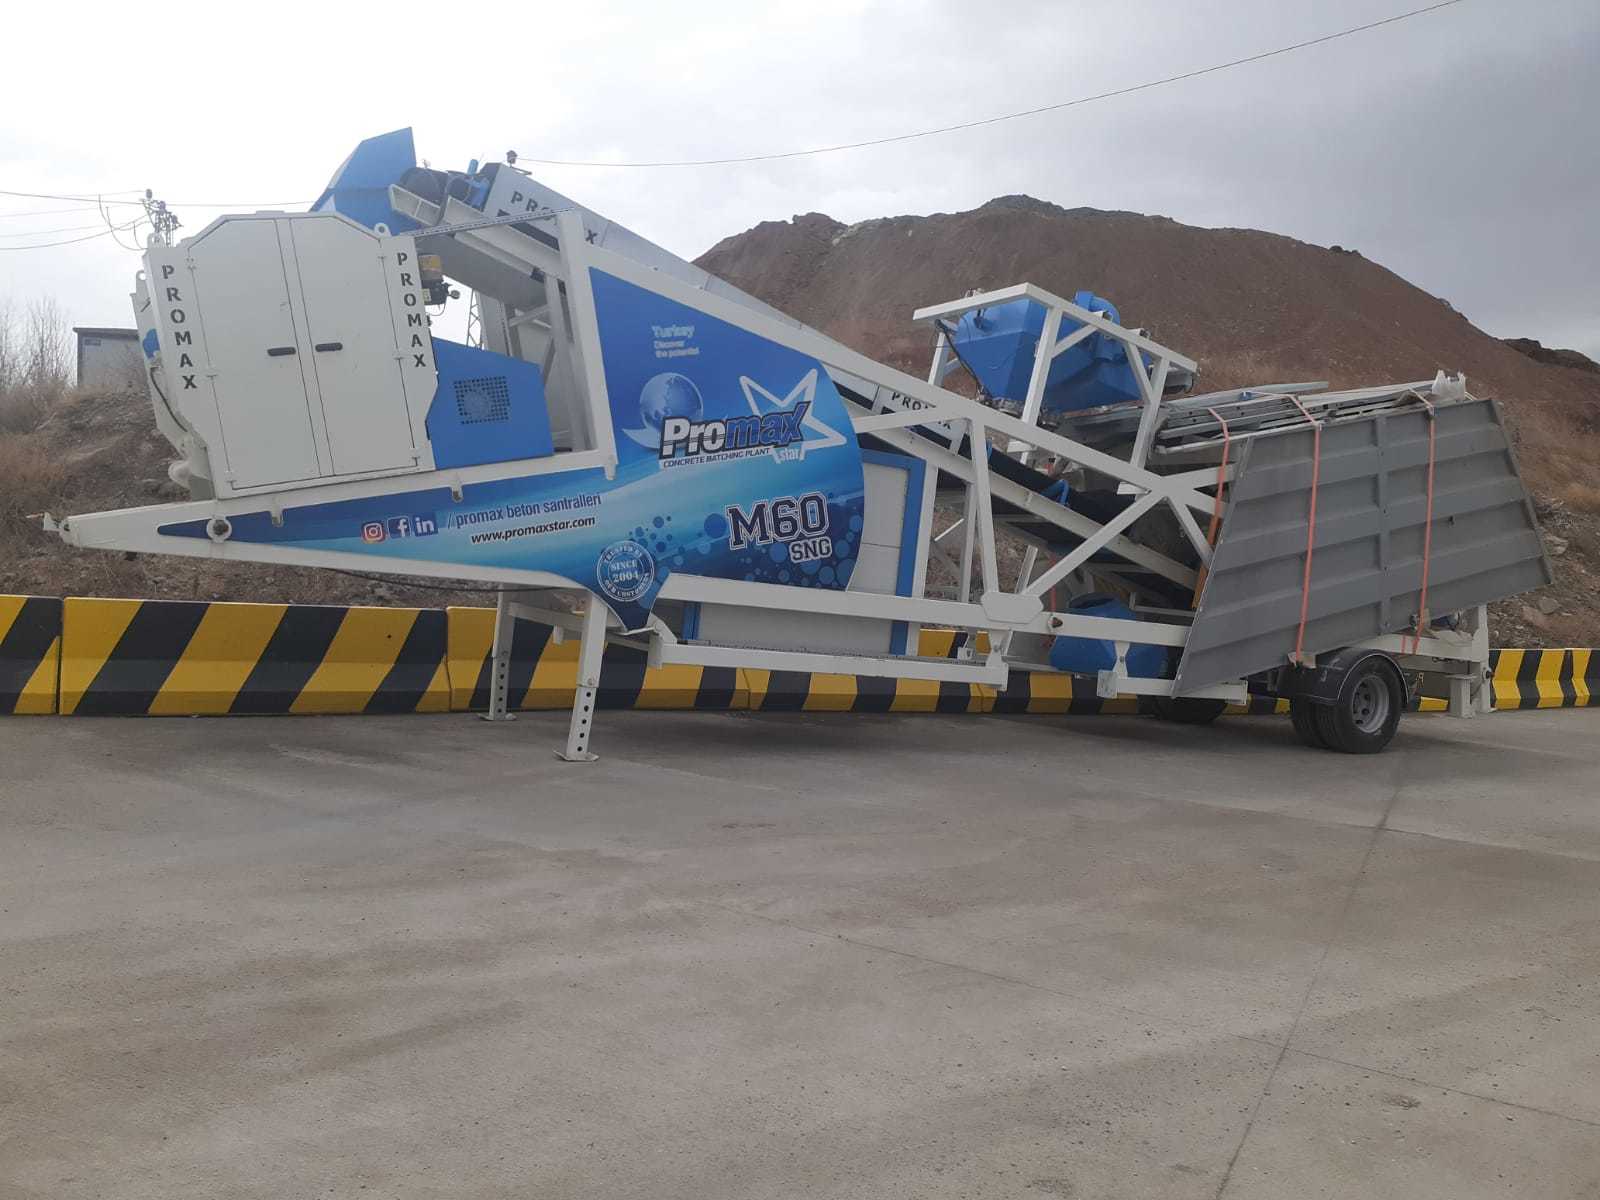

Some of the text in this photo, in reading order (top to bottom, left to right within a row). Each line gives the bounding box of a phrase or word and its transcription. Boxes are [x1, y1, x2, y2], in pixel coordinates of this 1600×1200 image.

[510, 191, 598, 245] PRX
[395, 252, 426, 368] PROMAX
[162, 264, 197, 389] PROMAX
[660, 401, 811, 459] Promax
[663, 448, 769, 468] CONCRETE BATCHING PLANT
[507, 503, 541, 519] beton
[543, 492, 602, 513] santralleri
[471, 516, 595, 543] www.promaxstar.com
[725, 491, 829, 549] M60
[789, 536, 832, 563] SNG
[611, 559, 638, 571] SINCE
[612, 571, 639, 583] 2004
